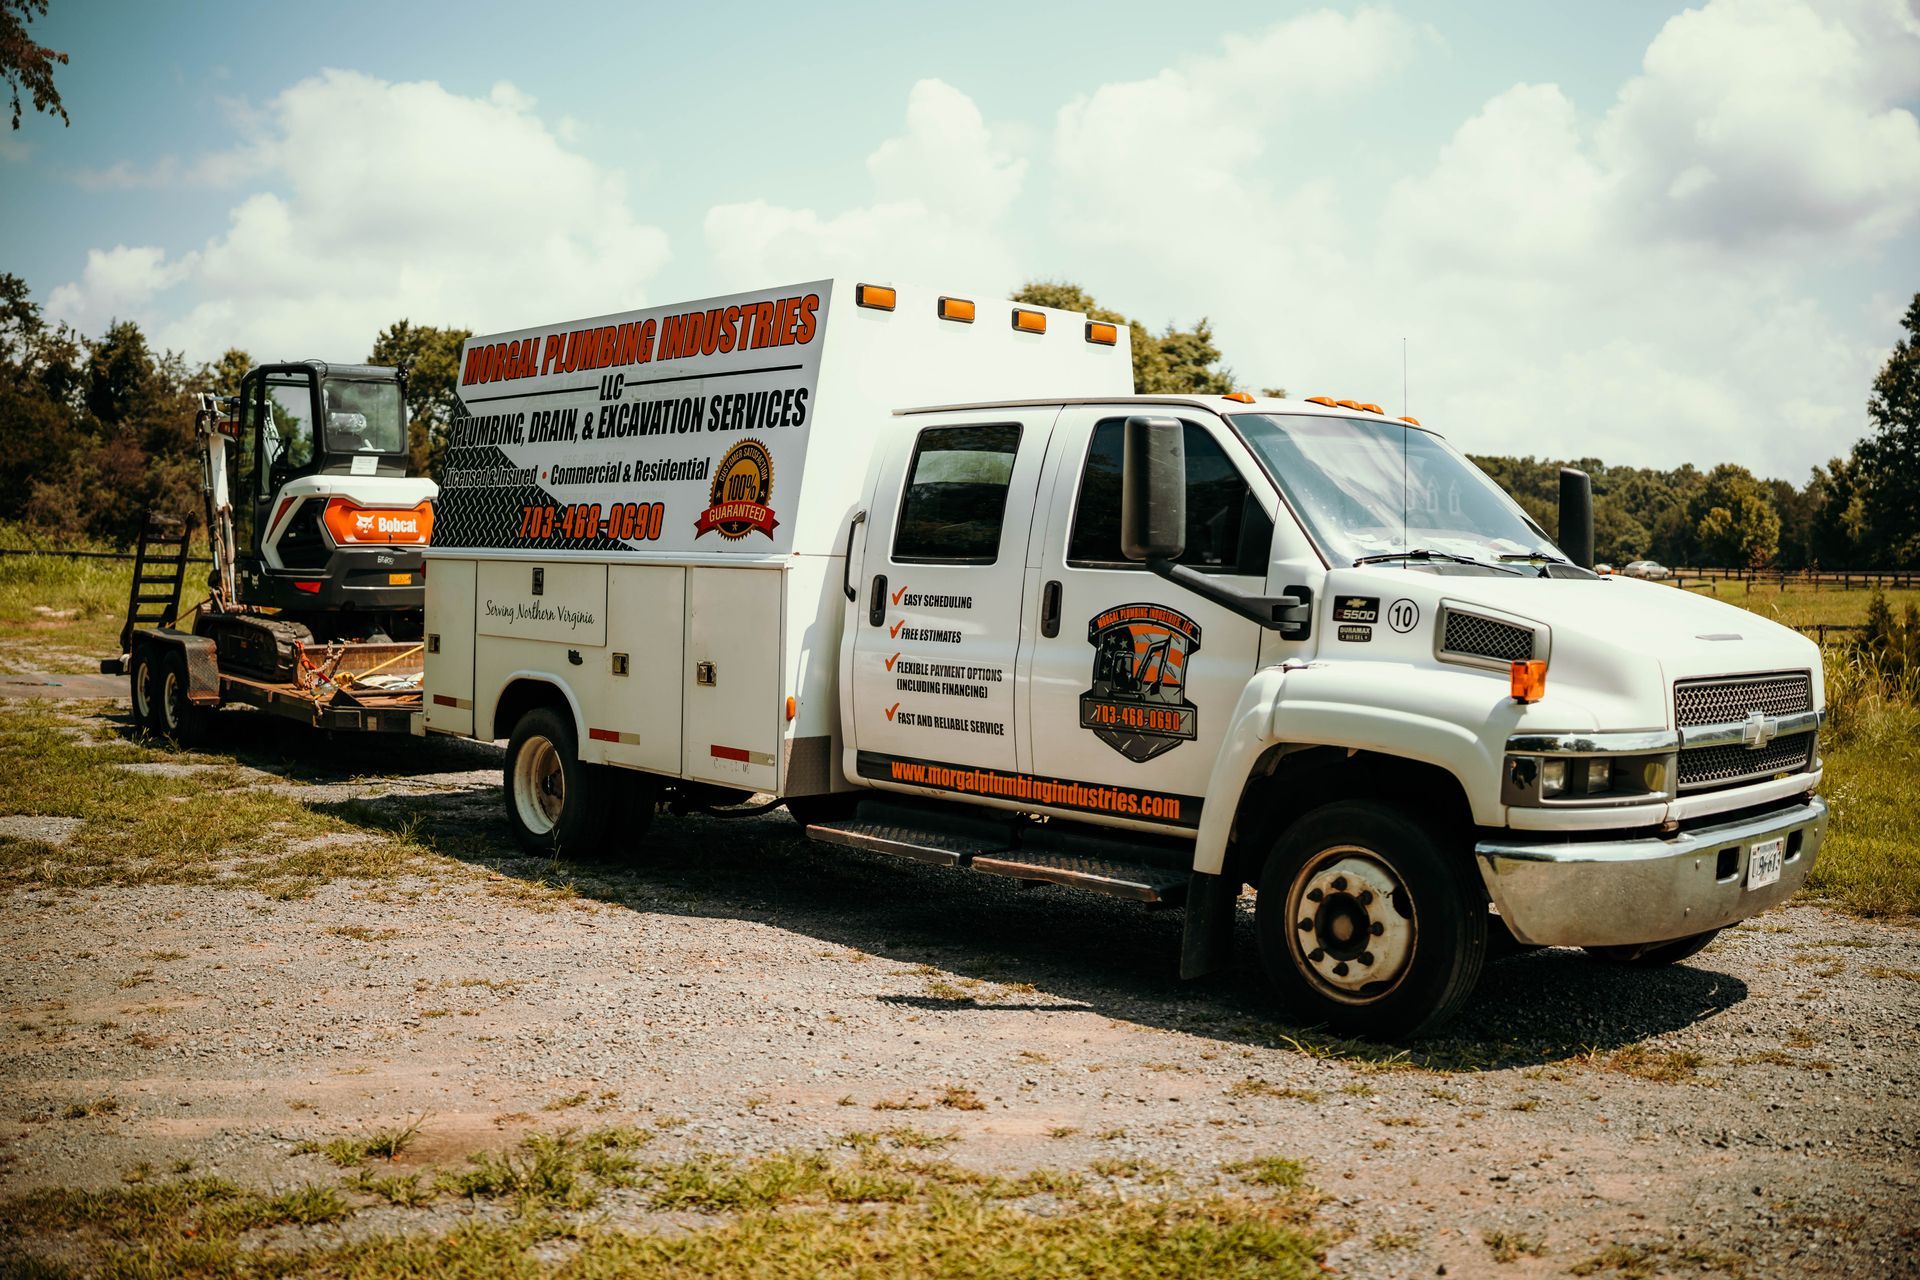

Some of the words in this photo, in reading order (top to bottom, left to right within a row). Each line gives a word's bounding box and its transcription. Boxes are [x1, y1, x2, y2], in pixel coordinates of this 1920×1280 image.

[462, 337, 543, 387] MORGAL
[542, 318, 658, 376] PLUMBING
[658, 294, 820, 361] INDUSTRIES
[600, 373, 625, 401] LLC
[452, 412, 525, 448] PLUMBING,
[528, 408, 578, 444] DRAIN,
[581, 411, 594, 441] &
[597, 395, 707, 439] EXCAVATION
[707, 387, 809, 432] SERVICES
[444, 466, 489, 488] Licensed
[488, 468, 497, 487] &
[497, 464, 538, 487] Insured
[550, 461, 623, 486] Commercial
[622, 463, 632, 483] &
[633, 457, 710, 483] Residential
[719, 449, 743, 482] CUSTOMER
[743, 447, 768, 480] SATISFACTION
[728, 473, 757, 501] 100%
[378, 517, 417, 533] Bobcat
[519, 502, 666, 541] 703-468-0690
[709, 504, 766, 522] GUARANTEED
[903, 593, 923, 608] EASY
[923, 593, 973, 609] SCHEDULING
[485, 599, 514, 624] Serving
[516, 599, 556, 621] Northern
[557, 605, 595, 630] Virginia
[1097, 611, 1119, 628] MORGAL
[1120, 607, 1148, 620] PLUMBING
[1335, 608, 1376, 621] C5500
[1395, 605, 1412, 627] 10
[901, 626, 919, 642] FREE
[919, 628, 962, 644] ESTIMATES
[1340, 626, 1370, 634] DURAMAX
[897, 661, 929, 677] FLEXIBLE
[929, 664, 966, 680] PAYMENT
[966, 666, 1003, 683] OPTIONS
[896, 678, 940, 696] (INCLUDING
[941, 682, 988, 699] FINANCING)
[897, 711, 916, 727] FAST
[916, 713, 934, 728] AND
[934, 715, 969, 732] RELIABLE
[969, 718, 1005, 736] SERVICE
[1095, 704, 1181, 731] 703-468-0690
[891, 761, 1181, 820] www.morgalplumbingindustries.com
